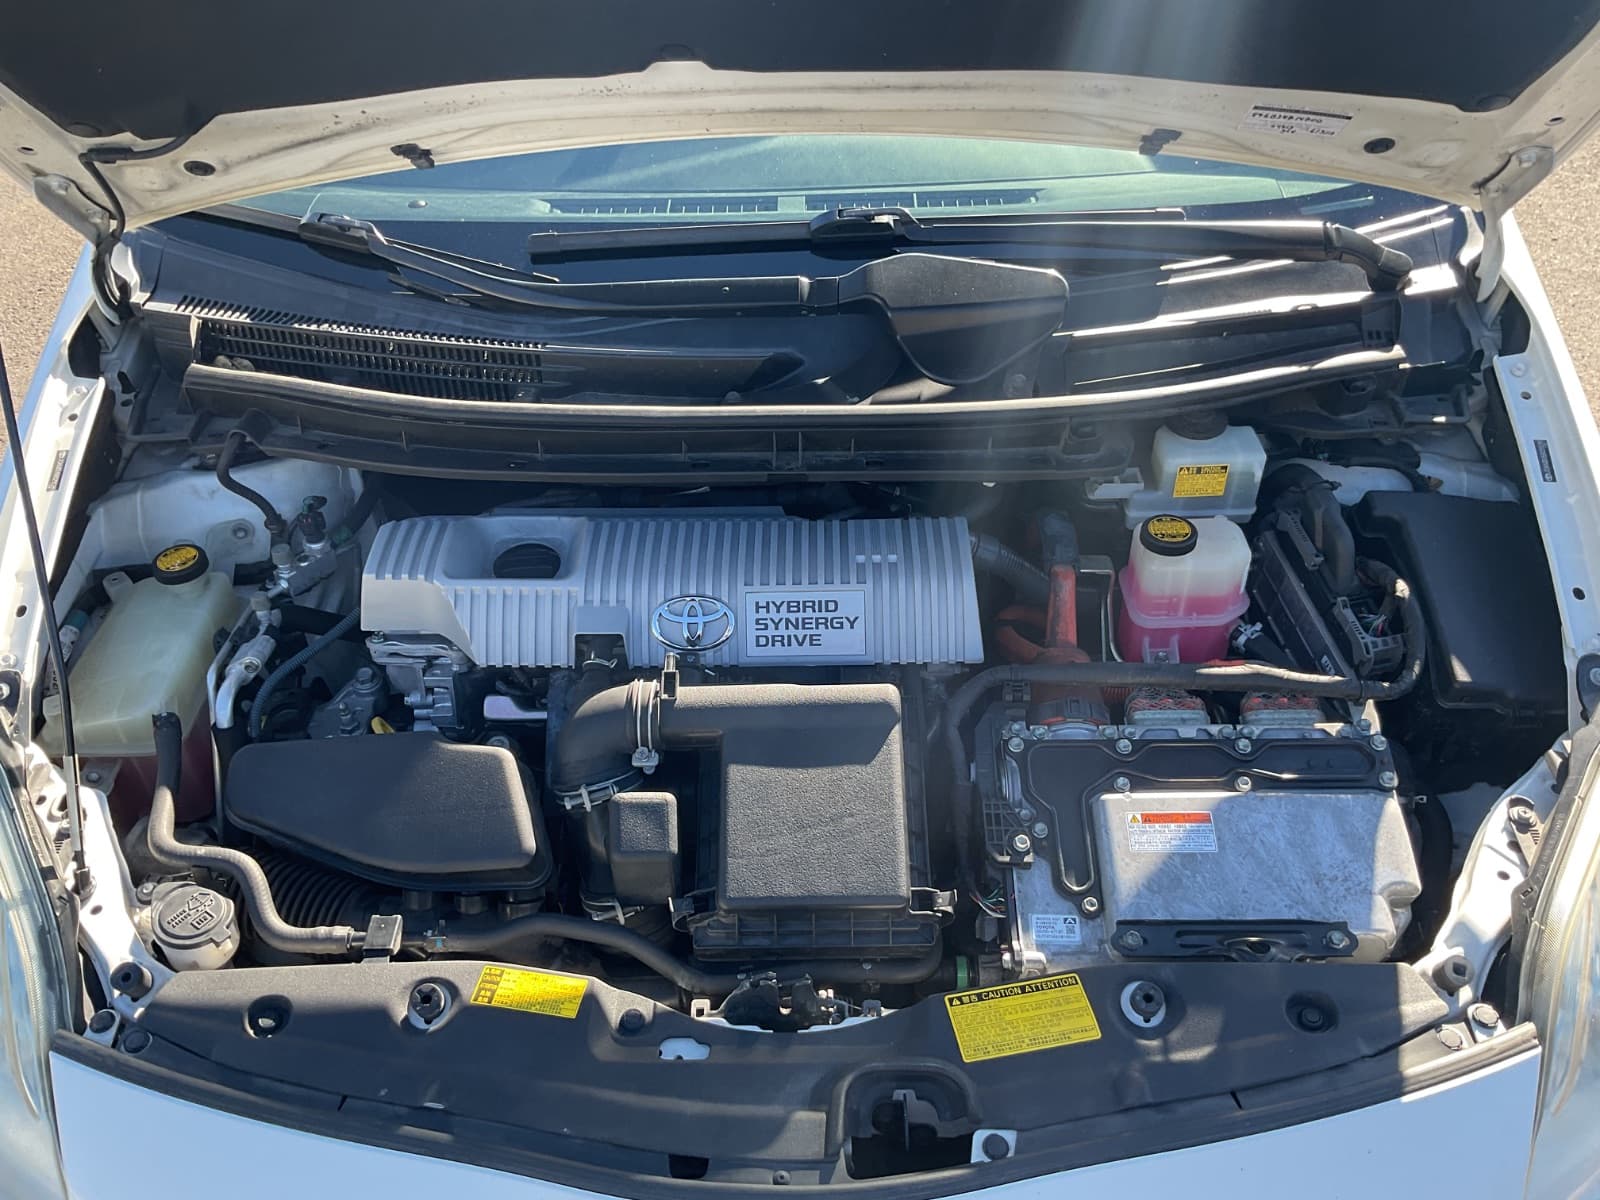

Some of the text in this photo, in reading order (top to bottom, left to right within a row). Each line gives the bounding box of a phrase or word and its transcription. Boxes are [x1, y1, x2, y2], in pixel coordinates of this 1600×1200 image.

[755, 600, 839, 614] HYBRID
[755, 616, 860, 631] SYNERGY
[755, 633, 822, 648] DRIVE
[981, 987, 1022, 1001] CAUTION
[1025, 977, 1077, 993] ATTENTION
